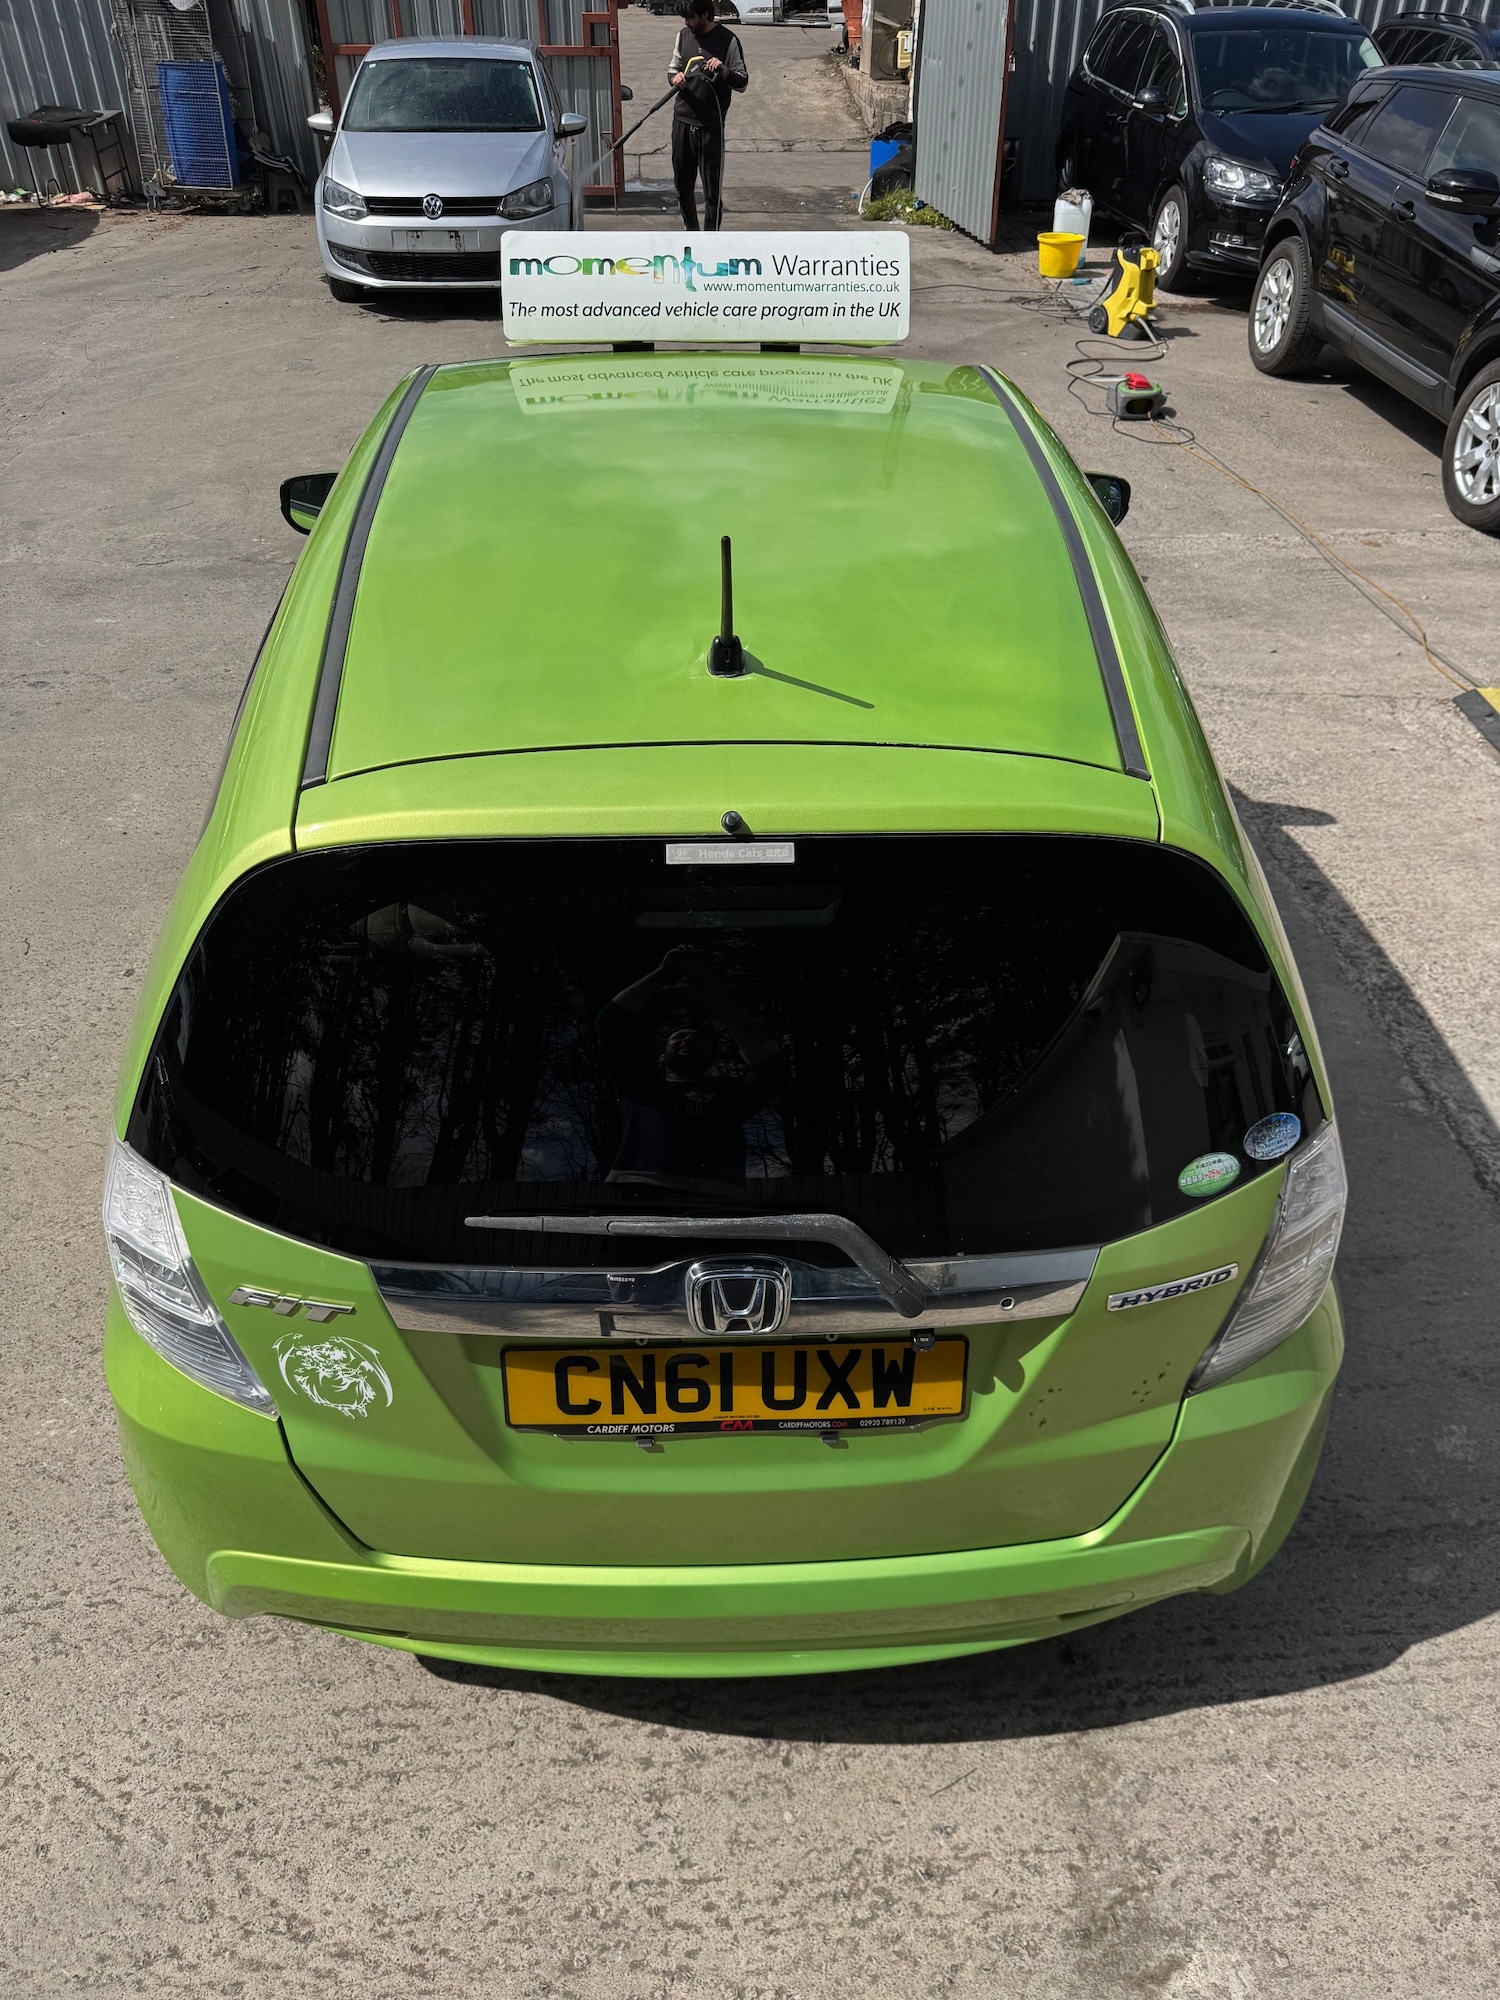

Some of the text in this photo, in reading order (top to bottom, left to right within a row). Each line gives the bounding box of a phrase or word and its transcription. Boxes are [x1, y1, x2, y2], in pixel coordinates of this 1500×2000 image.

[509, 246, 900, 292] momentum Warranties
[703, 281, 900, 294] www.momentumwarranties.co.uk
[509, 301, 900, 320] The most advanced vehicle care program in the UK
[1117, 1268, 1233, 1309] HYBRID
[227, 1286, 355, 1322] FIT
[554, 1348, 916, 1416] CN61 UXW
[587, 1424, 675, 1433] CARDIFF MOTORS
[778, 1420, 848, 1429] CARDIFFMOTORS.COM
[860, 1417, 906, 1427] 02920 789139
